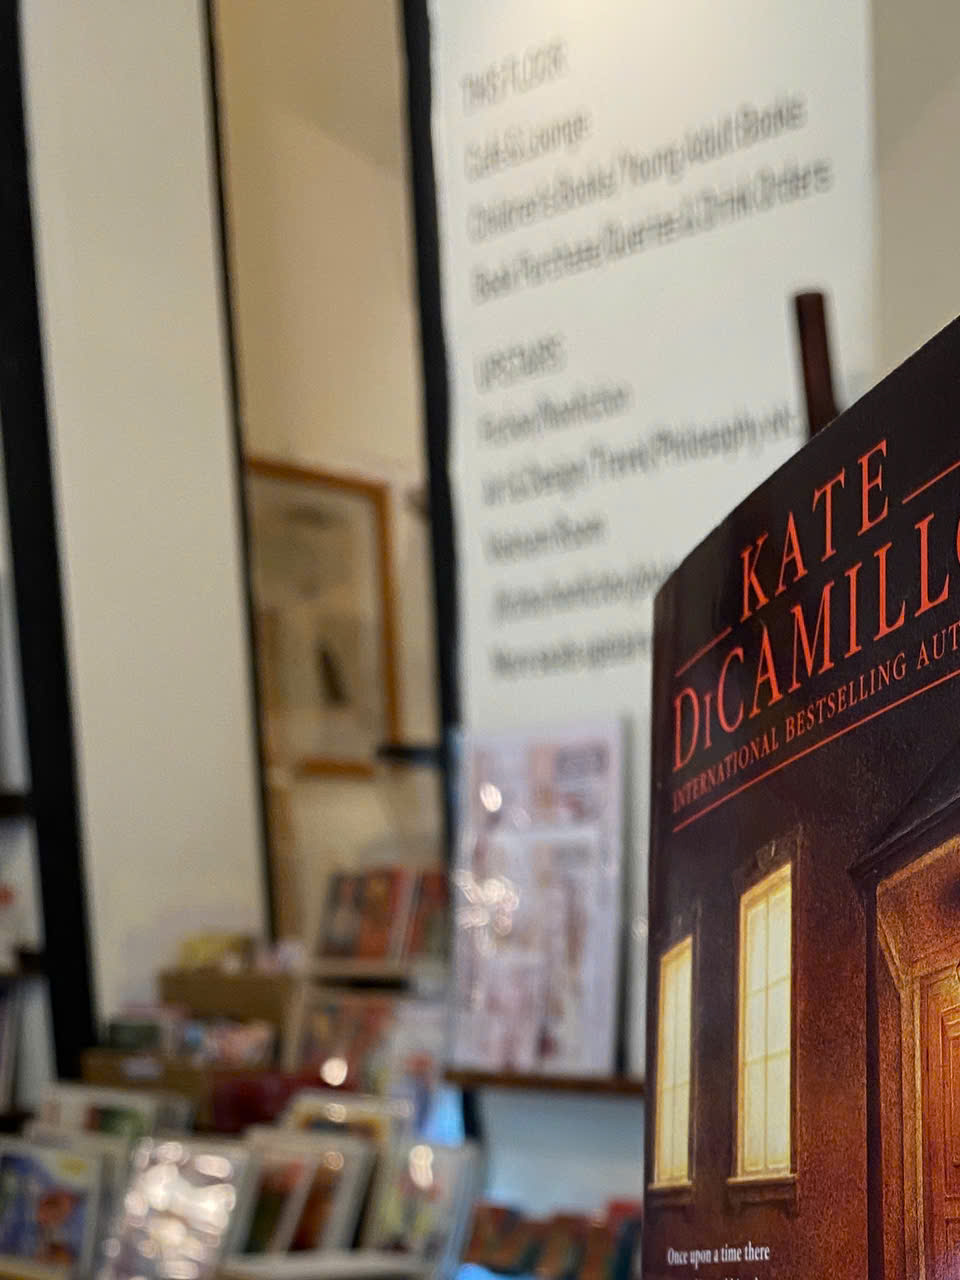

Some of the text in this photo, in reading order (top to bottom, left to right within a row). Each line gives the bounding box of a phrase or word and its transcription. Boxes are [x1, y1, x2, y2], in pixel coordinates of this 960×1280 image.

[739, 439, 889, 624] KATE
[672, 733, 779, 813] INTERNATIONAL
[785, 652, 907, 743] BESTSELLING
[667, 1240, 770, 1270] Once upon a time there
